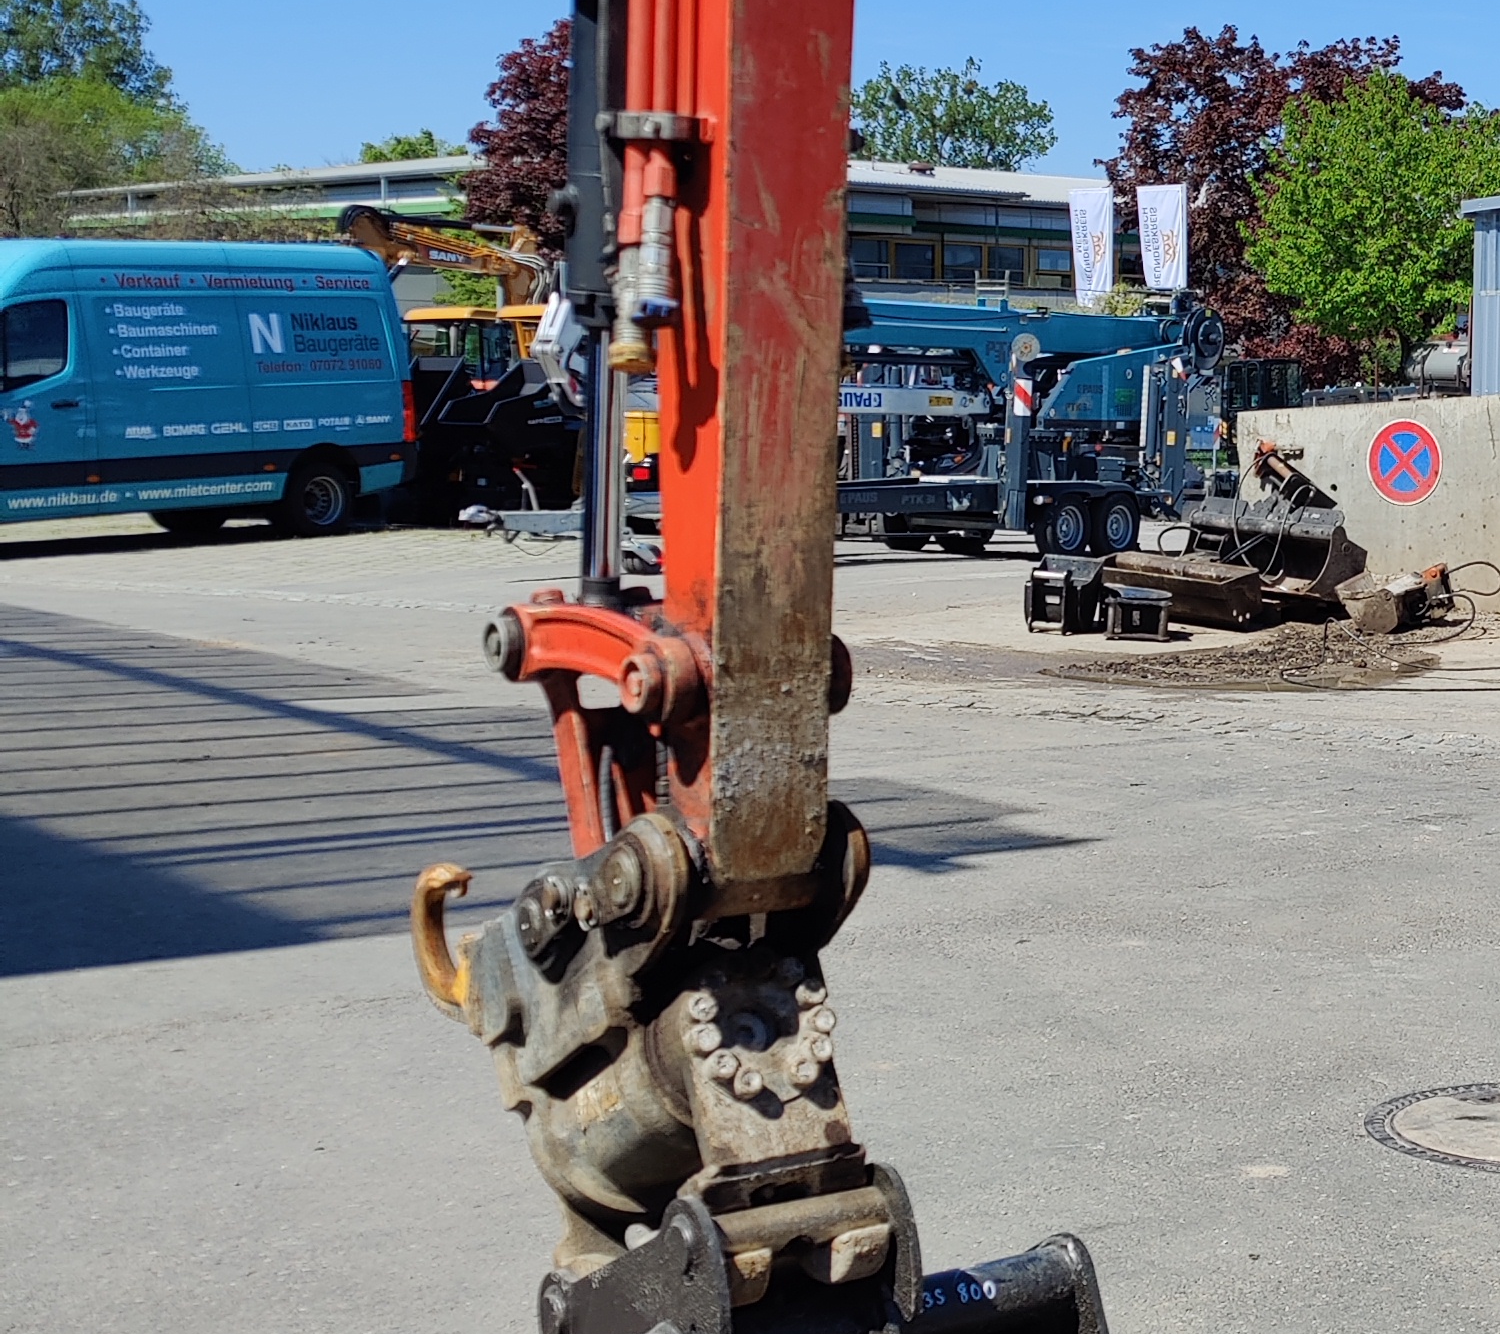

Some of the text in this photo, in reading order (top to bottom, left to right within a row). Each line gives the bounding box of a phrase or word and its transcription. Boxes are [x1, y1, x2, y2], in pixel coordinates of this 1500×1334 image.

[428, 250, 465, 263] SANY
[113, 273, 370, 292] Verkauf Vermietung Service
[113, 303, 185, 319] Baugeräte
[117, 323, 217, 338] Baumaschinen
[290, 313, 358, 331] Niklaus
[248, 313, 284, 354] N
[120, 343, 188, 358] Container
[293, 334, 380, 356] Baugeräte
[123, 365, 199, 379] Werkzeuge
[210, 422, 249, 434] GEHL
[7, 480, 273, 509] www.nikbau.de www.mietcenter.com
[957, 1280, 997, 1304] 800
